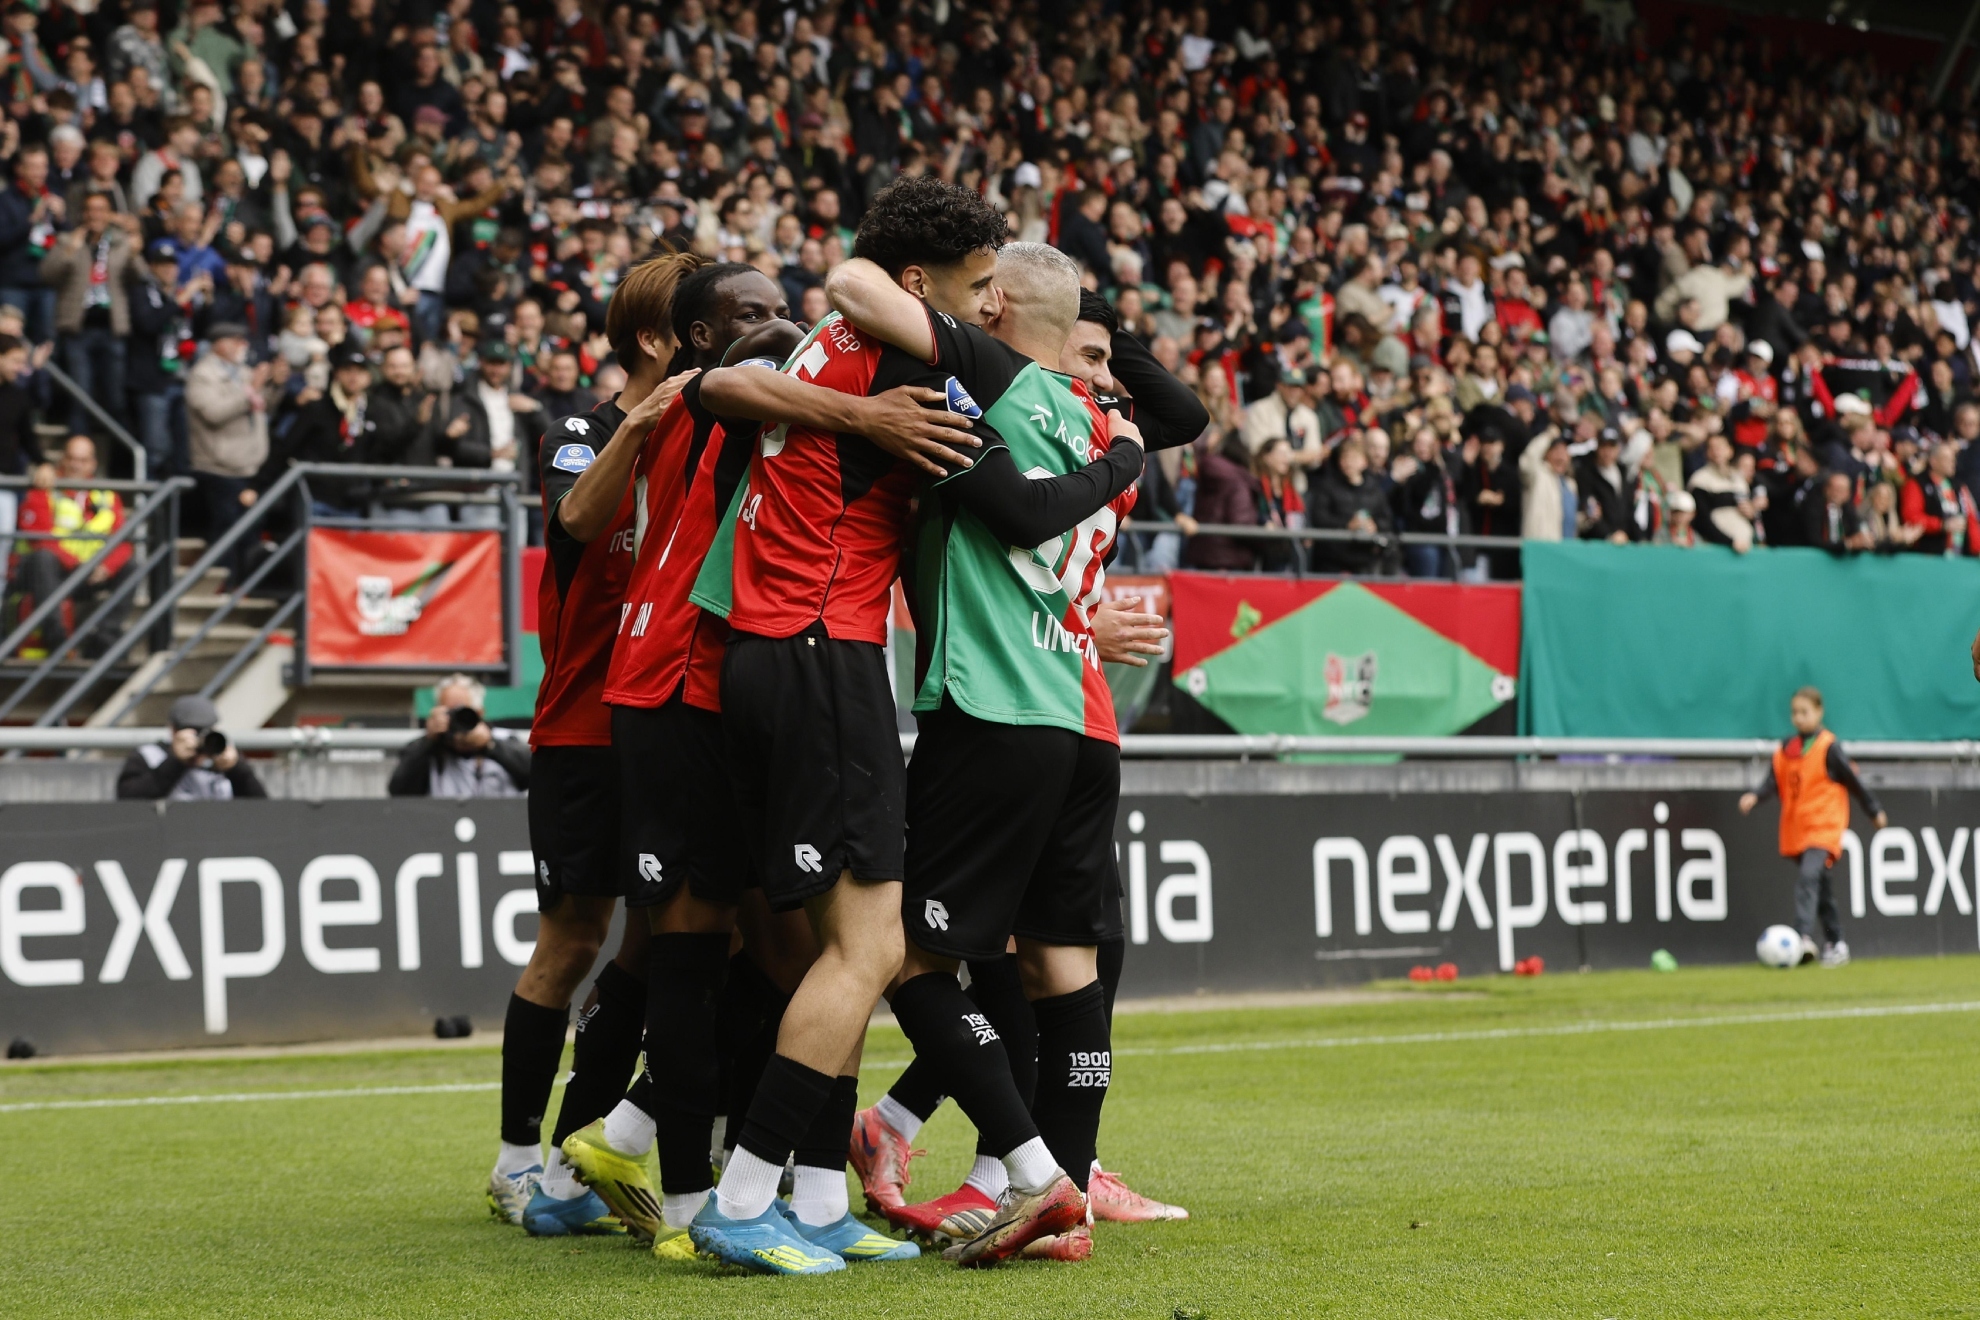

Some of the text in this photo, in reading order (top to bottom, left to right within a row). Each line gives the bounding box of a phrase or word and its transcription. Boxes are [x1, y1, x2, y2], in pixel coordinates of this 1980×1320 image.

[1312, 800, 1728, 972] nexperia
[1068, 1051, 1110, 1067] 1900
[1067, 1071, 1110, 1087] 2025
